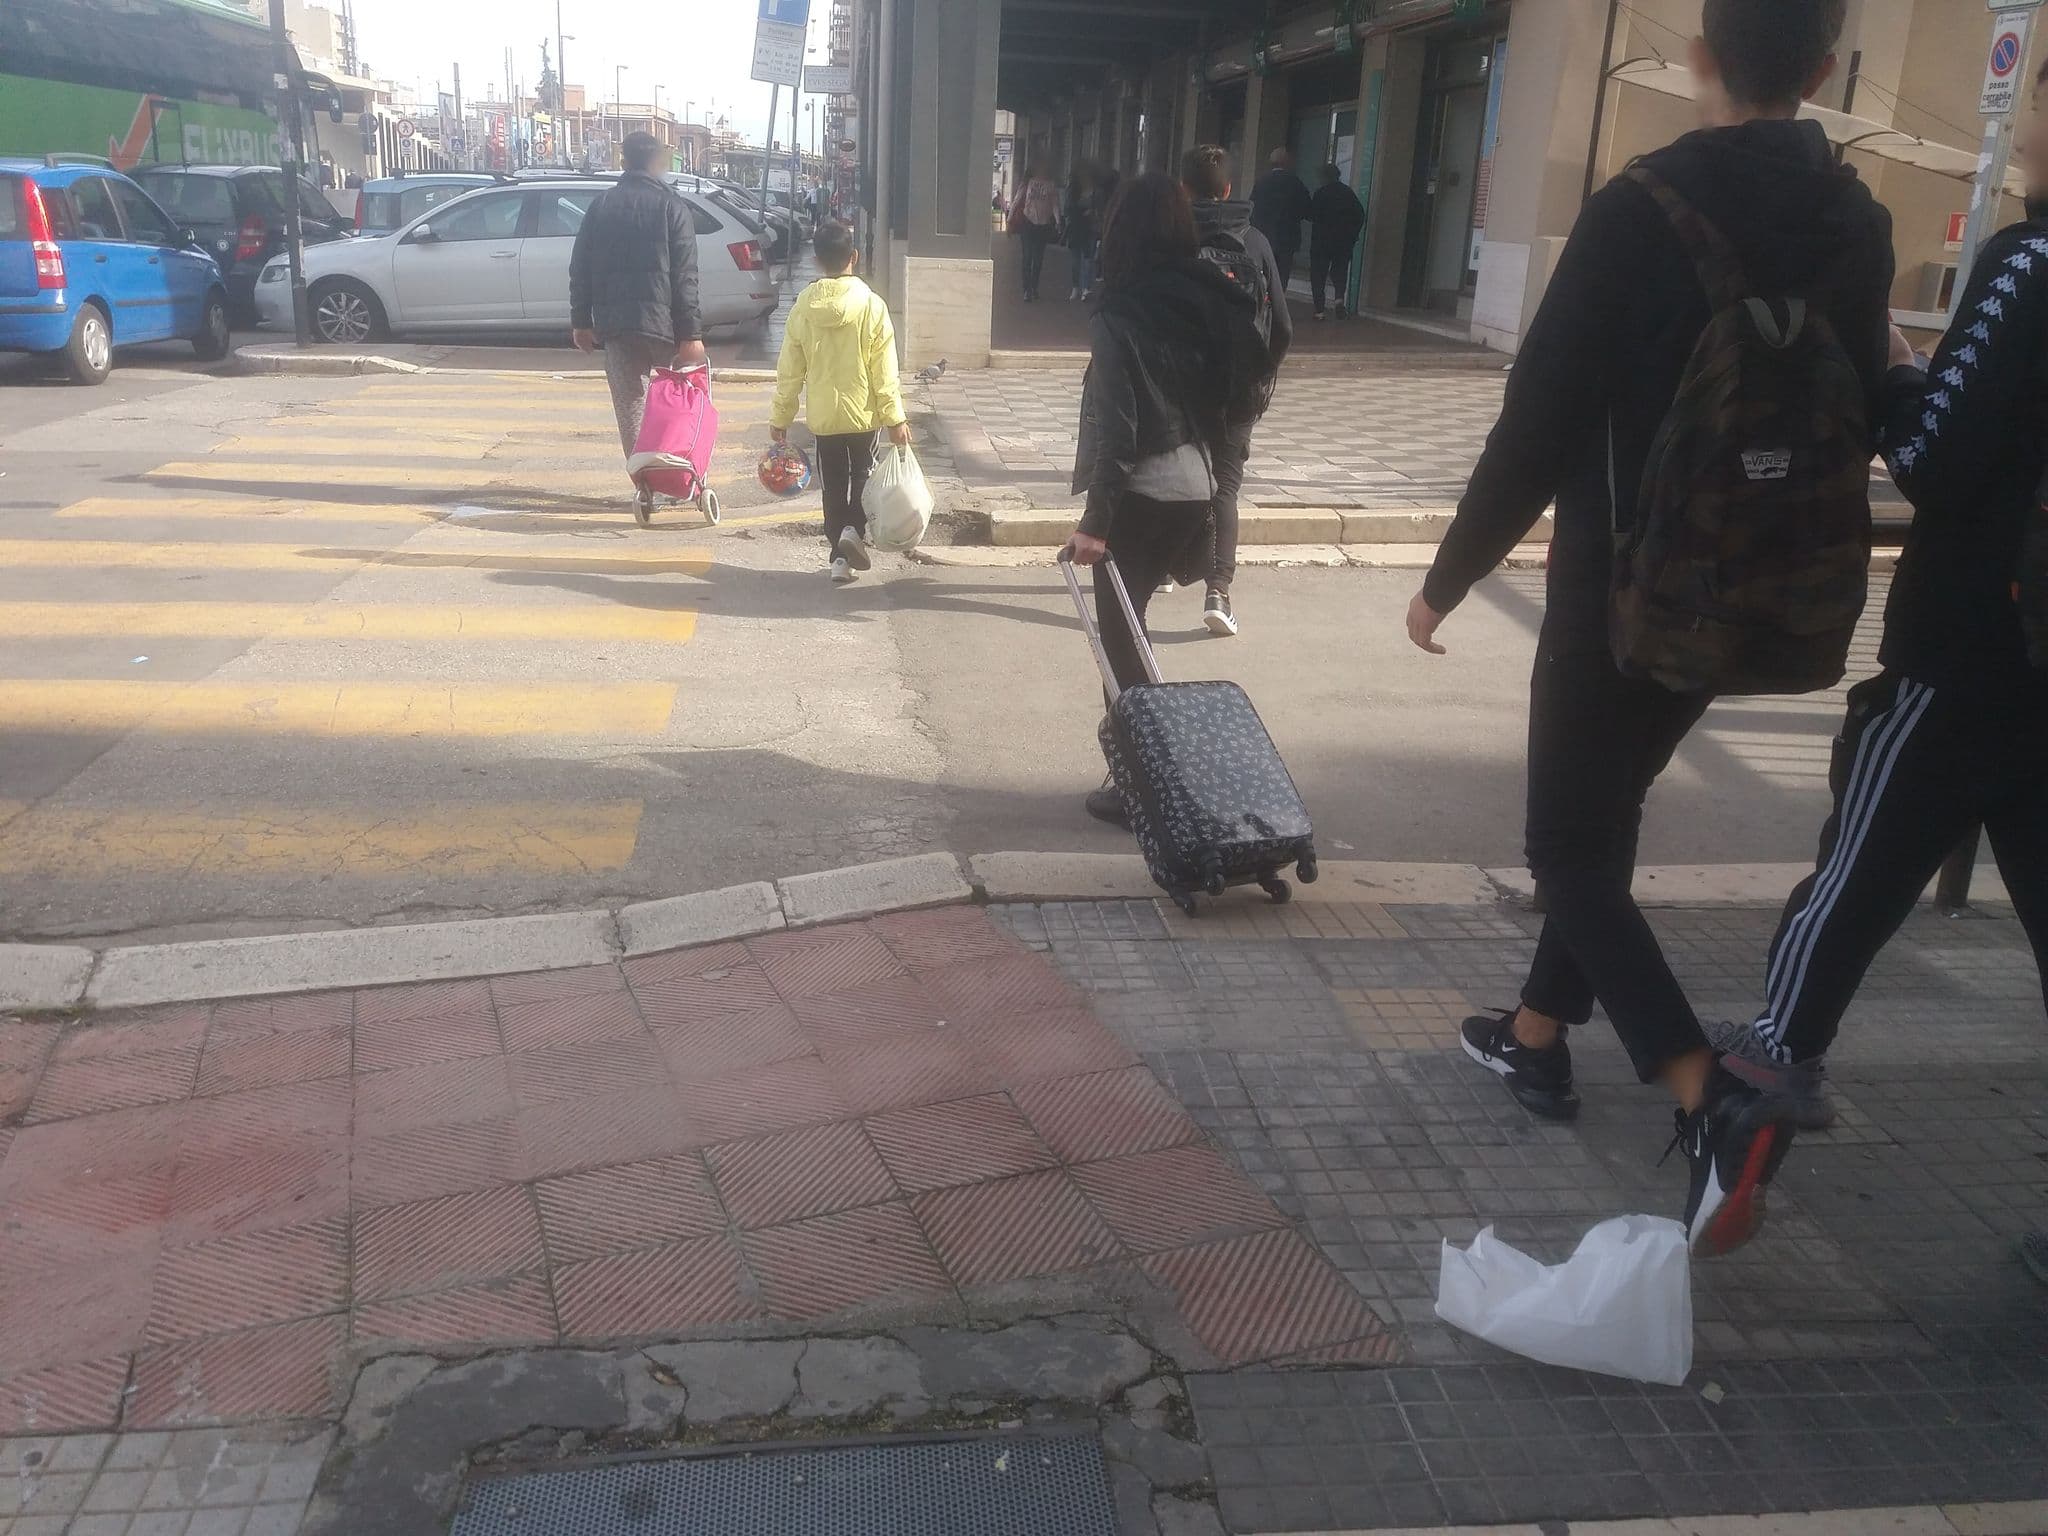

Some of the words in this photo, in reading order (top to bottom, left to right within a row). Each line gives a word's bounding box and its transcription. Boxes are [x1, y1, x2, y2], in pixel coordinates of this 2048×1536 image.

[1988, 81, 2009, 90] passo
[1982, 91, 2012, 101] carrabile
[1751, 456, 1783, 466] VANS
